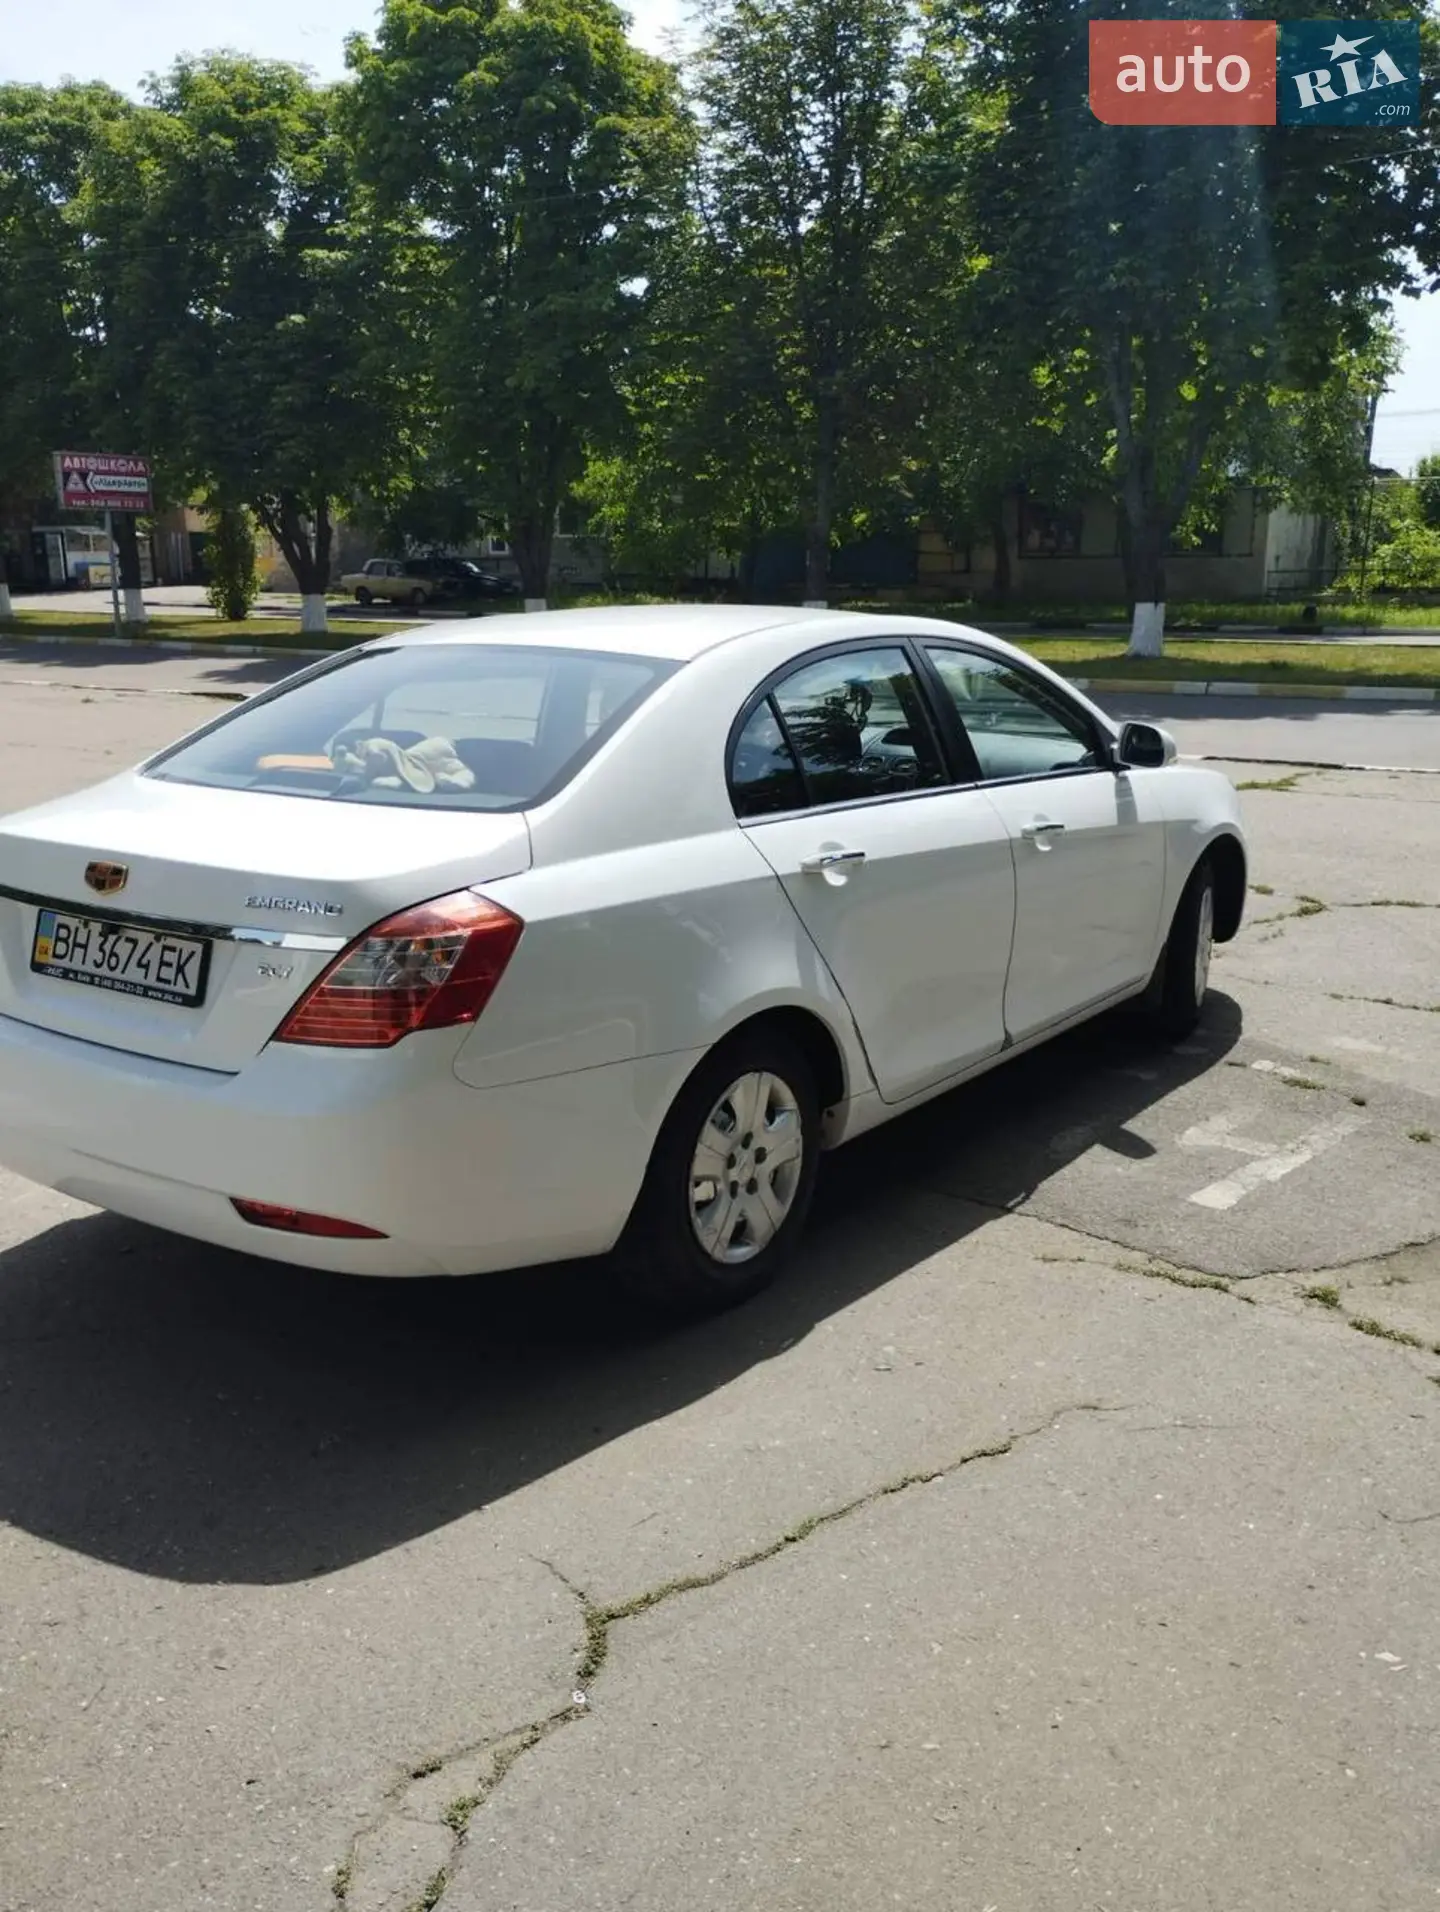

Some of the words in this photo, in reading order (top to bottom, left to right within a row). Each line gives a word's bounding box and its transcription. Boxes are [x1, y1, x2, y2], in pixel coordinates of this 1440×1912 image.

[63, 456, 146, 472] АВТОШКОЛА
[244, 895, 343, 916] EMGRAND
[93, 932, 154, 980] 3674
